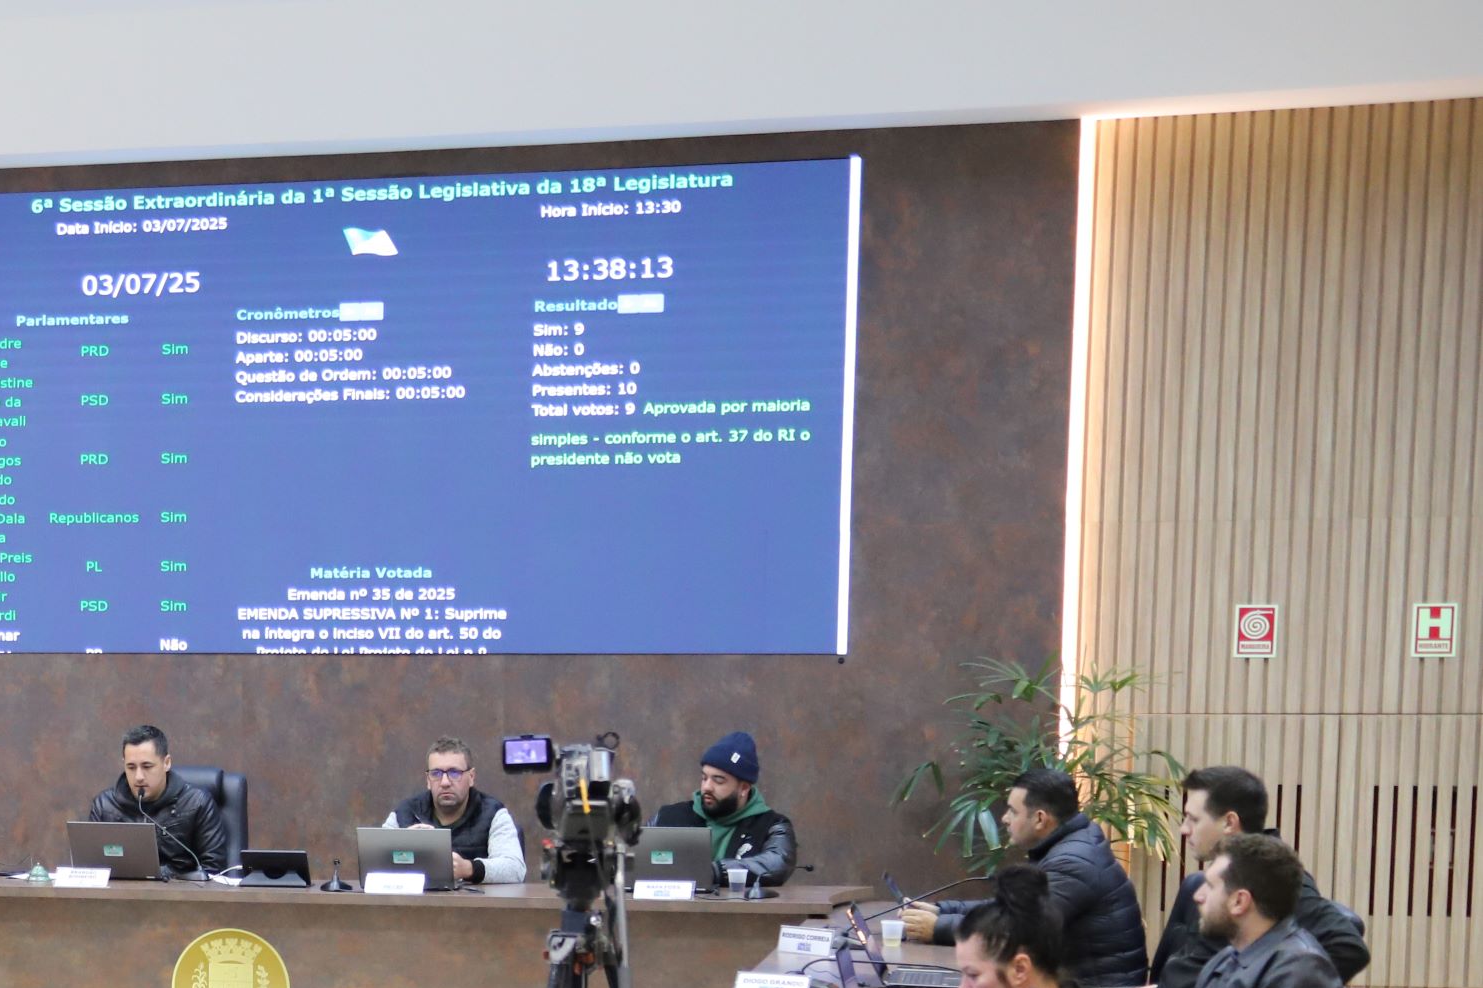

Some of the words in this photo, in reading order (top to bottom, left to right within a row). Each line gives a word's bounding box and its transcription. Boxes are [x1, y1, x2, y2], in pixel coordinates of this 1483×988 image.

[31, 199, 53, 213] 6ª
[59, 196, 127, 212] Sessão
[134, 190, 274, 209] Extraordinária
[281, 189, 305, 204] da
[313, 187, 334, 203] 1ª
[342, 184, 412, 201] Sessão
[419, 181, 530, 201] Legislativa
[537, 179, 562, 194] da
[571, 177, 606, 193] 18ª
[614, 174, 733, 194] Legislatura
[541, 205, 576, 217] Hora
[582, 203, 628, 216] Início:
[636, 200, 681, 214] 13:30
[57, 223, 89, 235] Data
[94, 221, 137, 234] Início:
[142, 217, 227, 233] 03/07/2025
[548, 256, 673, 281] 13:38:13
[82, 272, 199, 298] 03/07/25
[536, 295, 619, 313] Resultado
[16, 314, 129, 326] Parlamentares
[237, 308, 339, 321] Cronômetros
[534, 324, 568, 336] Sim:
[574, 322, 584, 335] 9
[236, 332, 302, 344] Discurso:
[308, 328, 377, 342] 00:05:00
[81, 345, 109, 356] PRD
[162, 344, 188, 354] Sim
[533, 343, 568, 356] Não:
[574, 342, 584, 355] 0
[236, 351, 288, 366] Aparte:
[294, 348, 362, 362] 00:05:00
[236, 370, 295, 385] Questão
[299, 369, 317, 381] de
[322, 368, 376, 381] Ordem:
[383, 366, 451, 379] 00:05:00
[532, 362, 623, 378] Abstenções:
[630, 361, 640, 374] 0
[235, 389, 338, 404] Considerações
[343, 388, 390, 400] Finais:
[396, 386, 465, 399] 00:05:00
[532, 383, 610, 396] Presentes:
[618, 382, 637, 395] 10
[5, 397, 21, 407] da
[81, 395, 108, 406] PSD
[162, 393, 187, 404] Sim
[531, 403, 567, 416] Total
[572, 403, 619, 416] votos:
[625, 402, 635, 415] 9
[643, 401, 715, 416] Aprovada
[721, 402, 748, 415] por
[752, 399, 810, 412] maioria
[531, 433, 588, 447] simples
[605, 431, 676, 444] conforme
[681, 433, 691, 443] o
[696, 430, 722, 442] art.
[729, 429, 748, 442] 37
[753, 429, 772, 441] do
[778, 428, 795, 441] RI
[800, 430, 810, 441] o
[81, 454, 108, 464] PRD
[161, 453, 187, 464] Sim
[531, 453, 609, 468] presidente
[615, 452, 643, 464] não
[648, 452, 680, 463] vota
[50, 512, 139, 525] Republicanos
[161, 512, 186, 522] Sim
[0, 553, 32, 563] Preis
[87, 561, 102, 572] PL
[161, 561, 186, 571] Sim
[311, 566, 370, 578] Matéria
[375, 567, 432, 578] Votada
[288, 588, 345, 600] Emenda
[350, 588, 367, 600] nº
[372, 588, 390, 600] 35
[395, 588, 413, 600] de
[418, 588, 455, 600] 2025
[81, 601, 107, 611] PSD
[161, 600, 186, 611] Sim
[238, 608, 299, 620] EMENDA
[303, 608, 396, 620] SUPRESSIVA
[400, 608, 419, 619] Nº
[425, 608, 438, 619] 1:
[445, 608, 507, 622] Suprime
[1419, 608, 1451, 638] H
[242, 629, 260, 639] na
[265, 627, 314, 642] íntegra
[319, 629, 328, 639] o
[333, 627, 374, 639] inciso
[378, 627, 400, 639] VII
[405, 627, 423, 639] do
[428, 627, 453, 639] art.
[460, 627, 478, 639] 50
[483, 627, 501, 639] do
[160, 638, 187, 650] Não
[782, 932, 806, 940] RODRIGO
[807, 934, 830, 942] CORREIA
